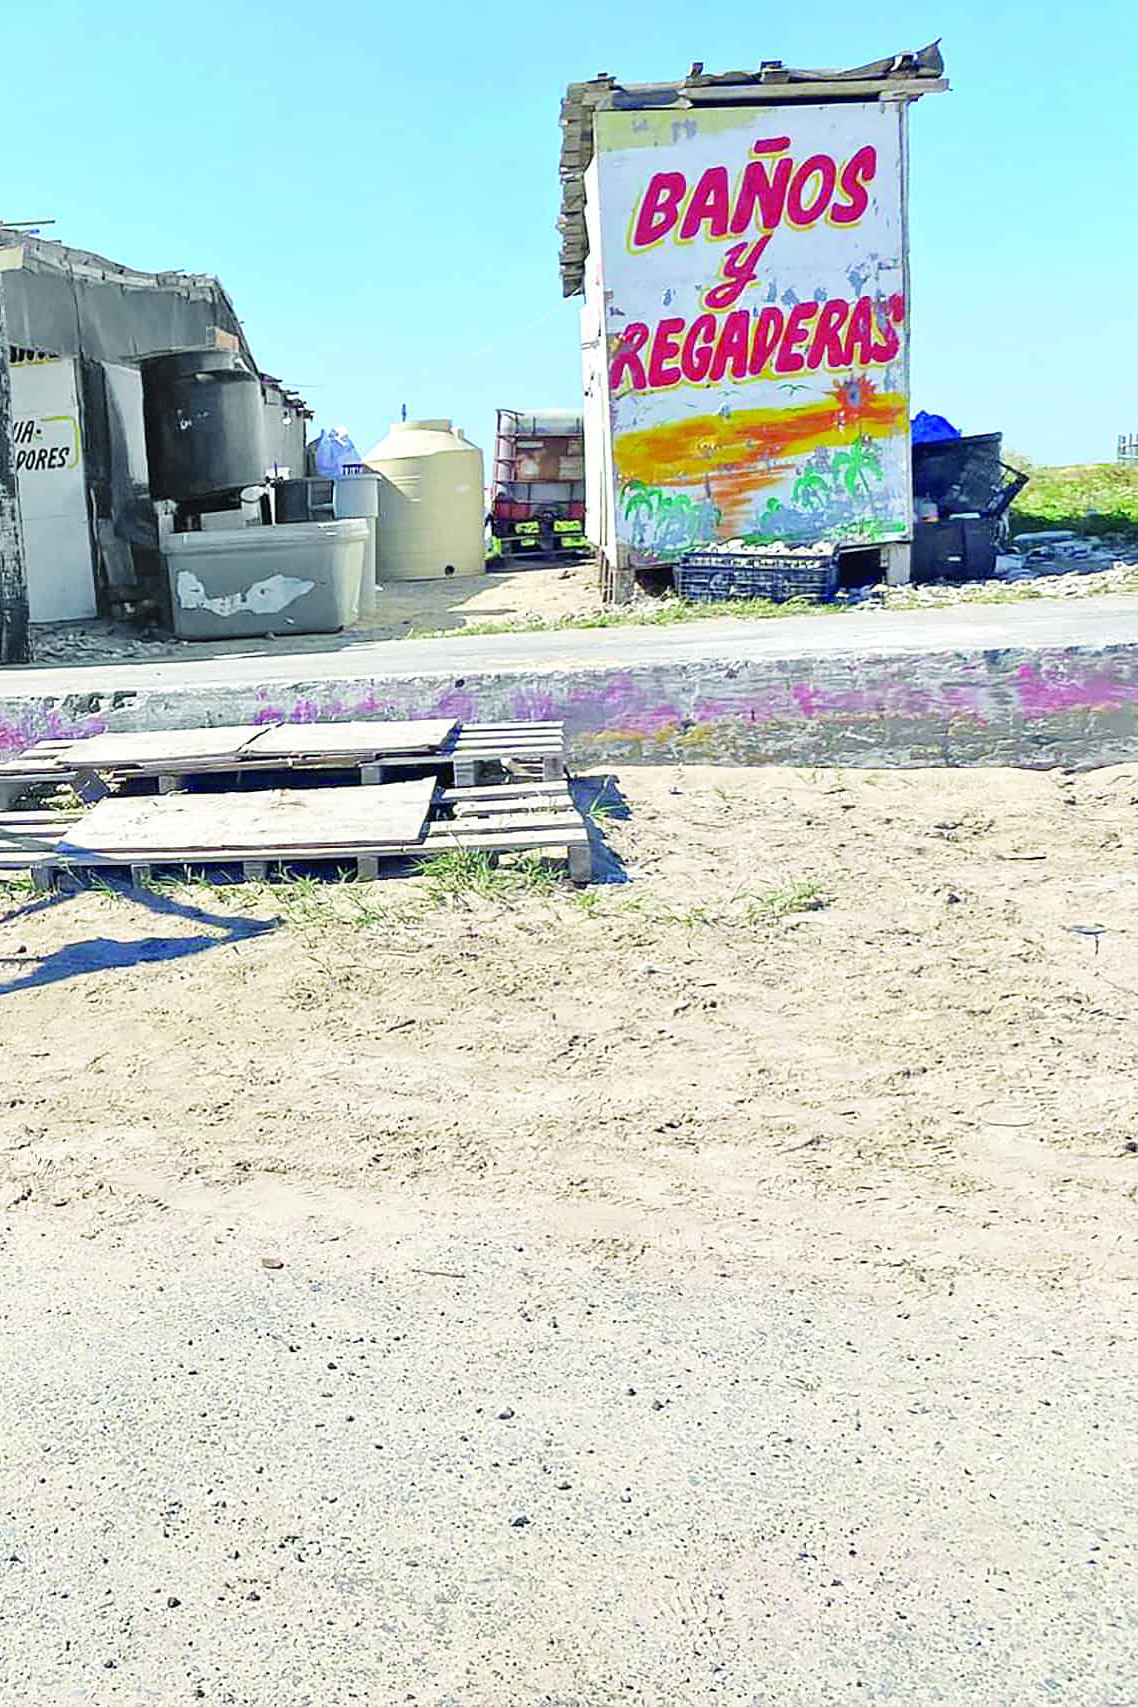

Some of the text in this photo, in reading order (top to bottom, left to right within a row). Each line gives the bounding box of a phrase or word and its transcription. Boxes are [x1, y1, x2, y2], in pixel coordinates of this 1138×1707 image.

[633, 136, 876, 248] BAÑOS
[609, 295, 905, 390] REGADERAS
[16, 446, 70, 471] DORES
